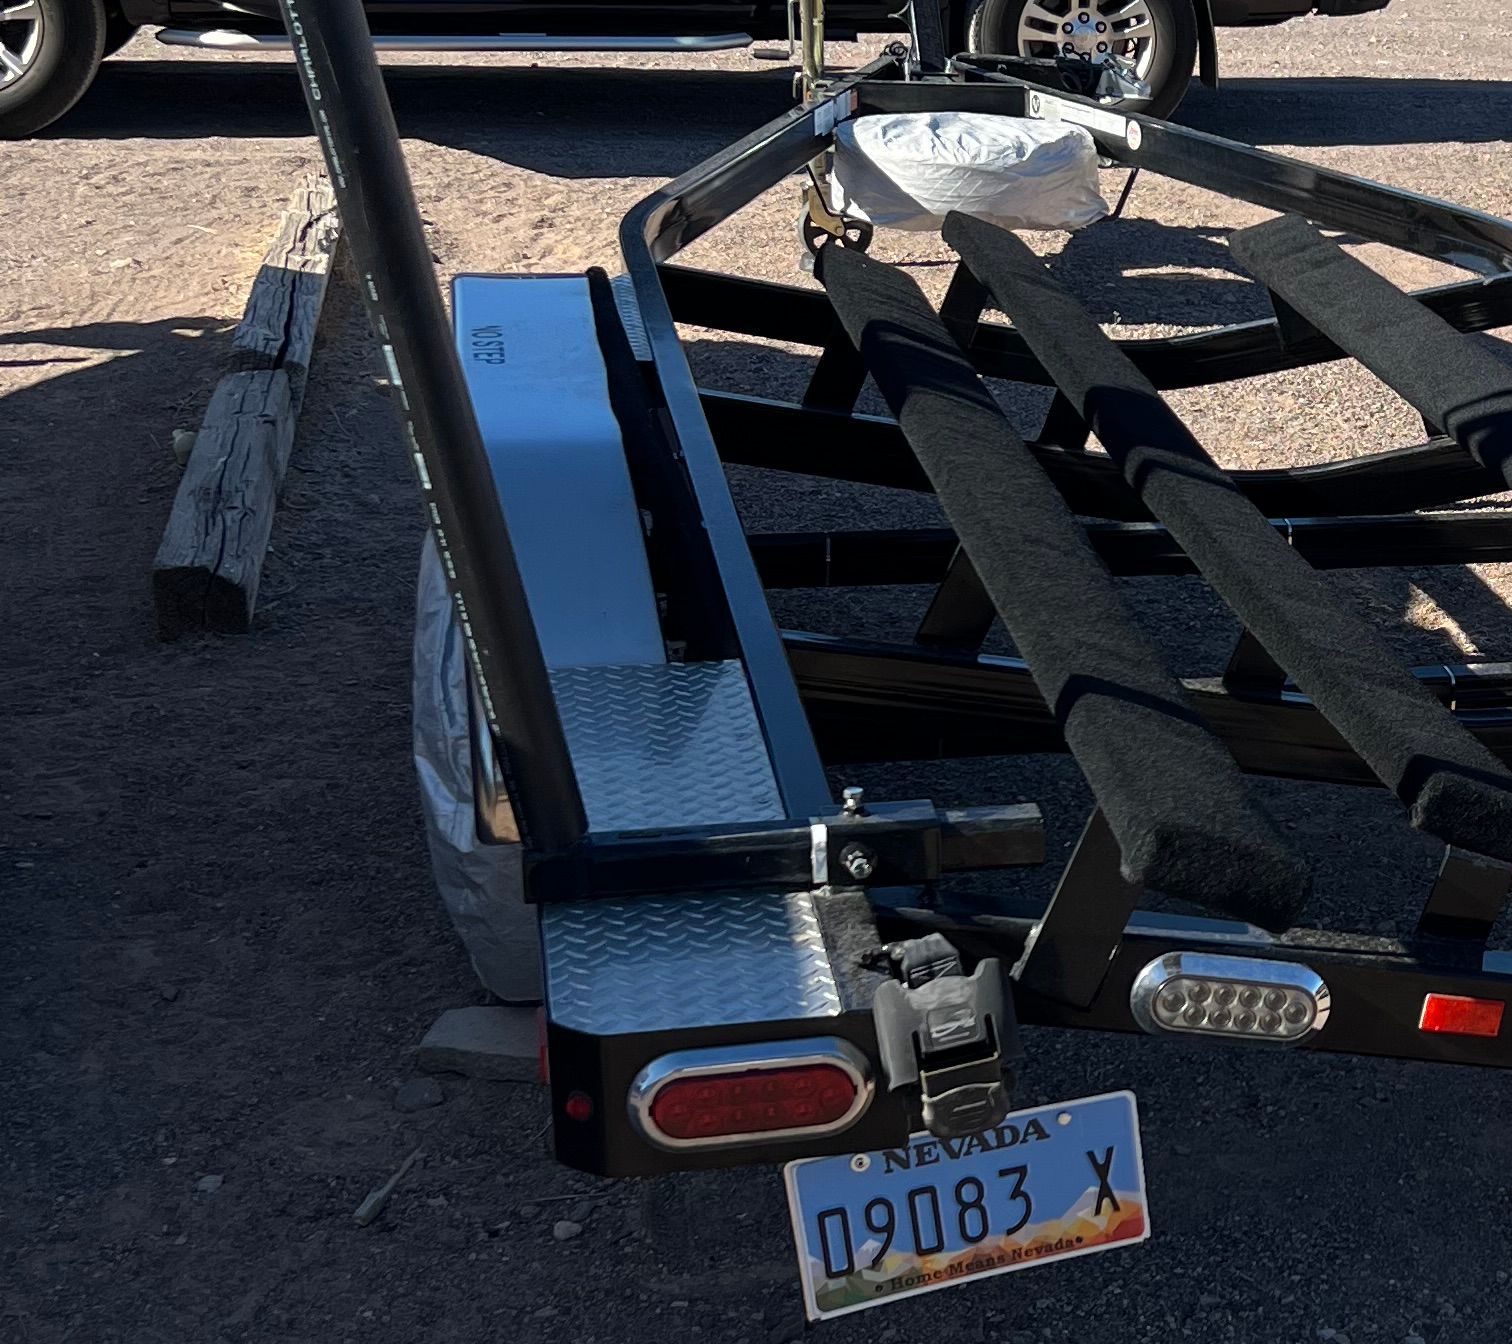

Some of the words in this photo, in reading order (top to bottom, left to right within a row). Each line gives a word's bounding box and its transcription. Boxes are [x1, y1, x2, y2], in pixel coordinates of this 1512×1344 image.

[882, 1118, 1051, 1174] NEVADA
[816, 1164, 1033, 1279] 09083
[1086, 1145, 1121, 1217] X
[891, 1268, 944, 1291] Home
[950, 1255, 1006, 1277] Means
[1012, 1238, 1074, 1260] Nevada
